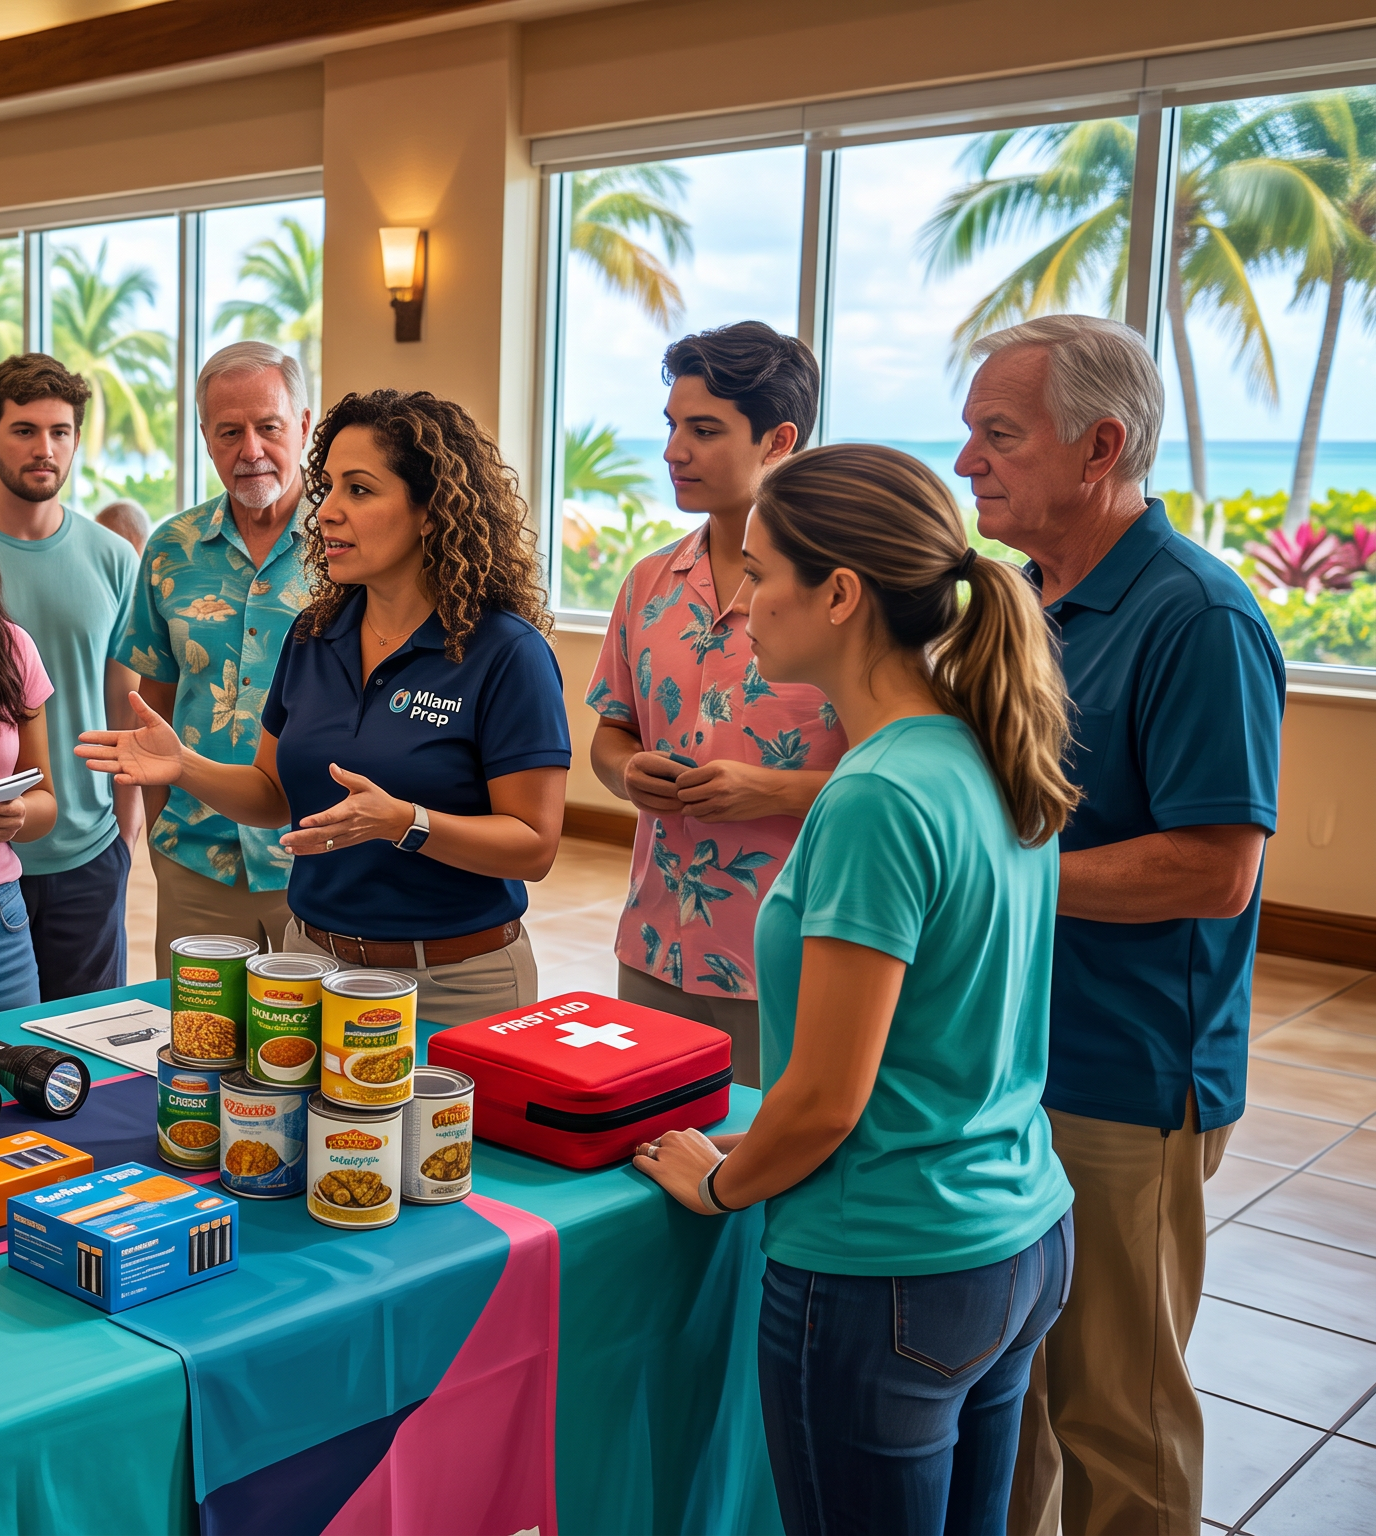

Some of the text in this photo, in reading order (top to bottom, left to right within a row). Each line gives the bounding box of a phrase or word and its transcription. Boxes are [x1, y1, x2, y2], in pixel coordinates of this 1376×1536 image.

[410, 706, 449, 727] Prep
[488, 1001, 590, 1035] FIRST AID
